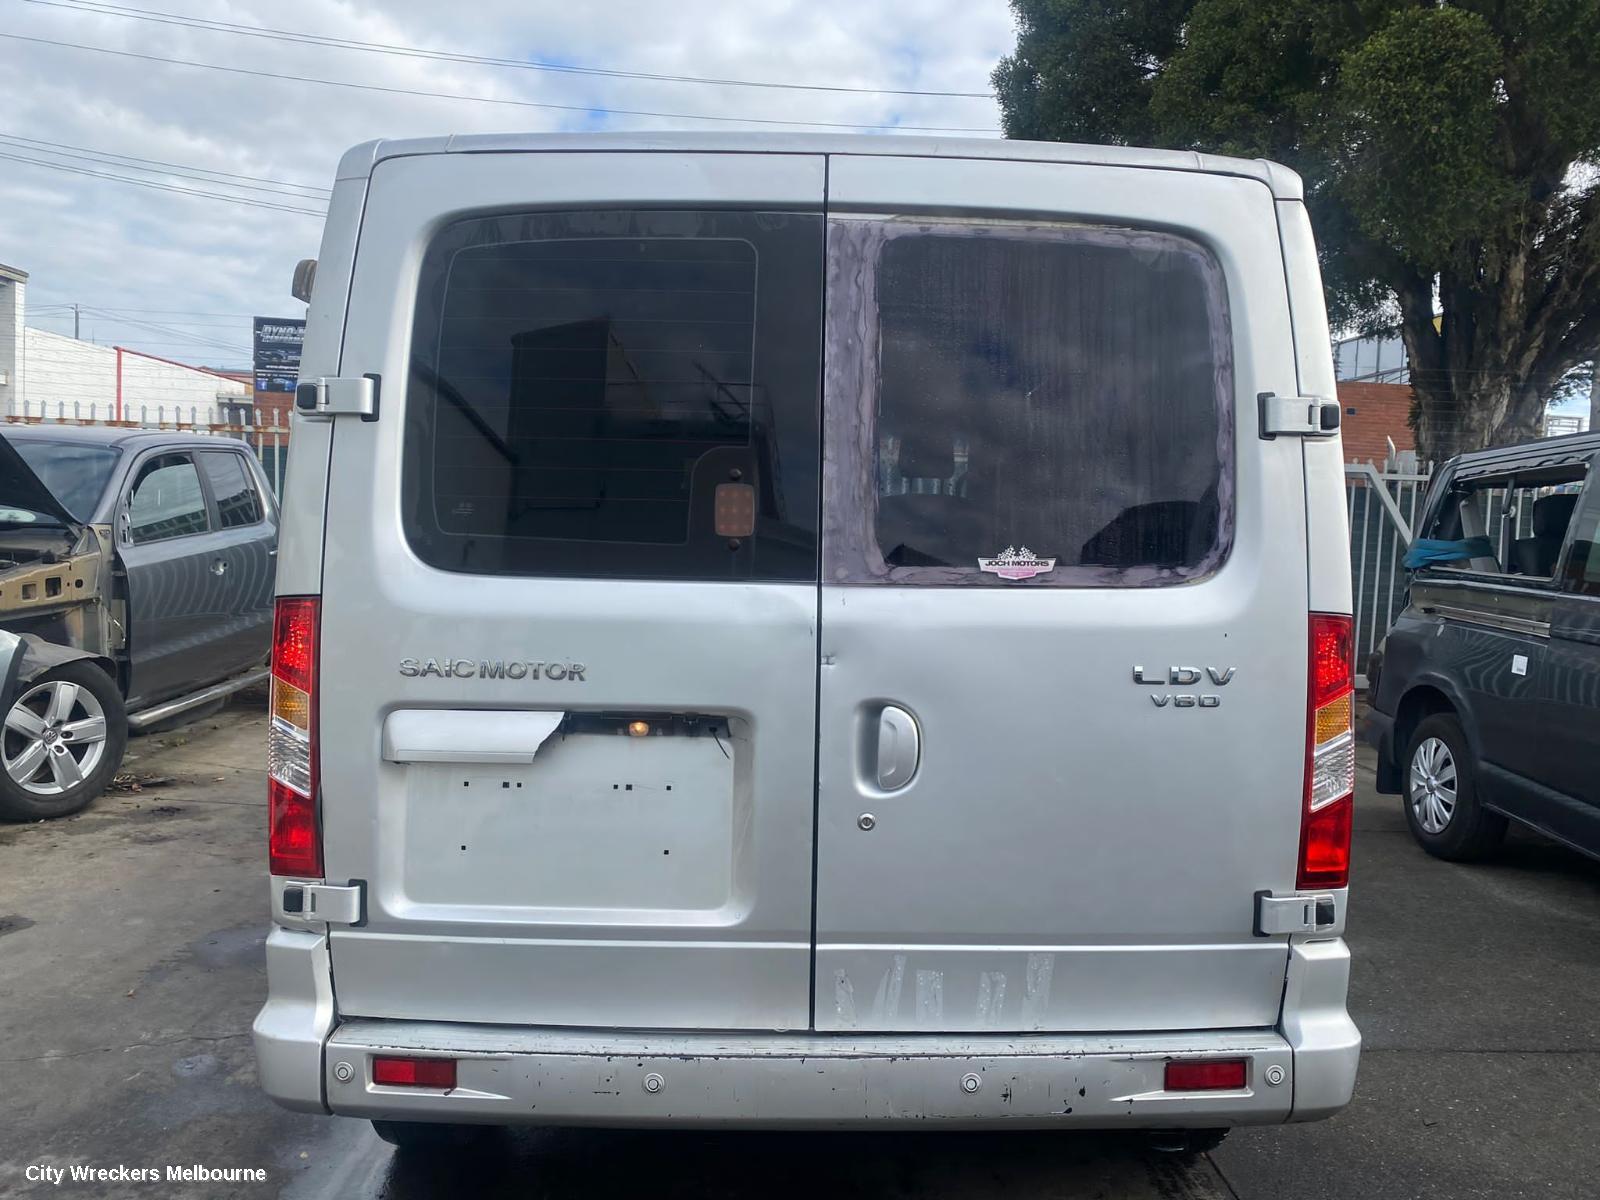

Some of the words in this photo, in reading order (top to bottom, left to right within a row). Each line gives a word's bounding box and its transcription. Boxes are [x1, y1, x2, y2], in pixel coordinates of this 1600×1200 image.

[399, 656, 475, 678] SAIC
[479, 659, 587, 681] MOTOR
[1132, 665, 1237, 686] LDV
